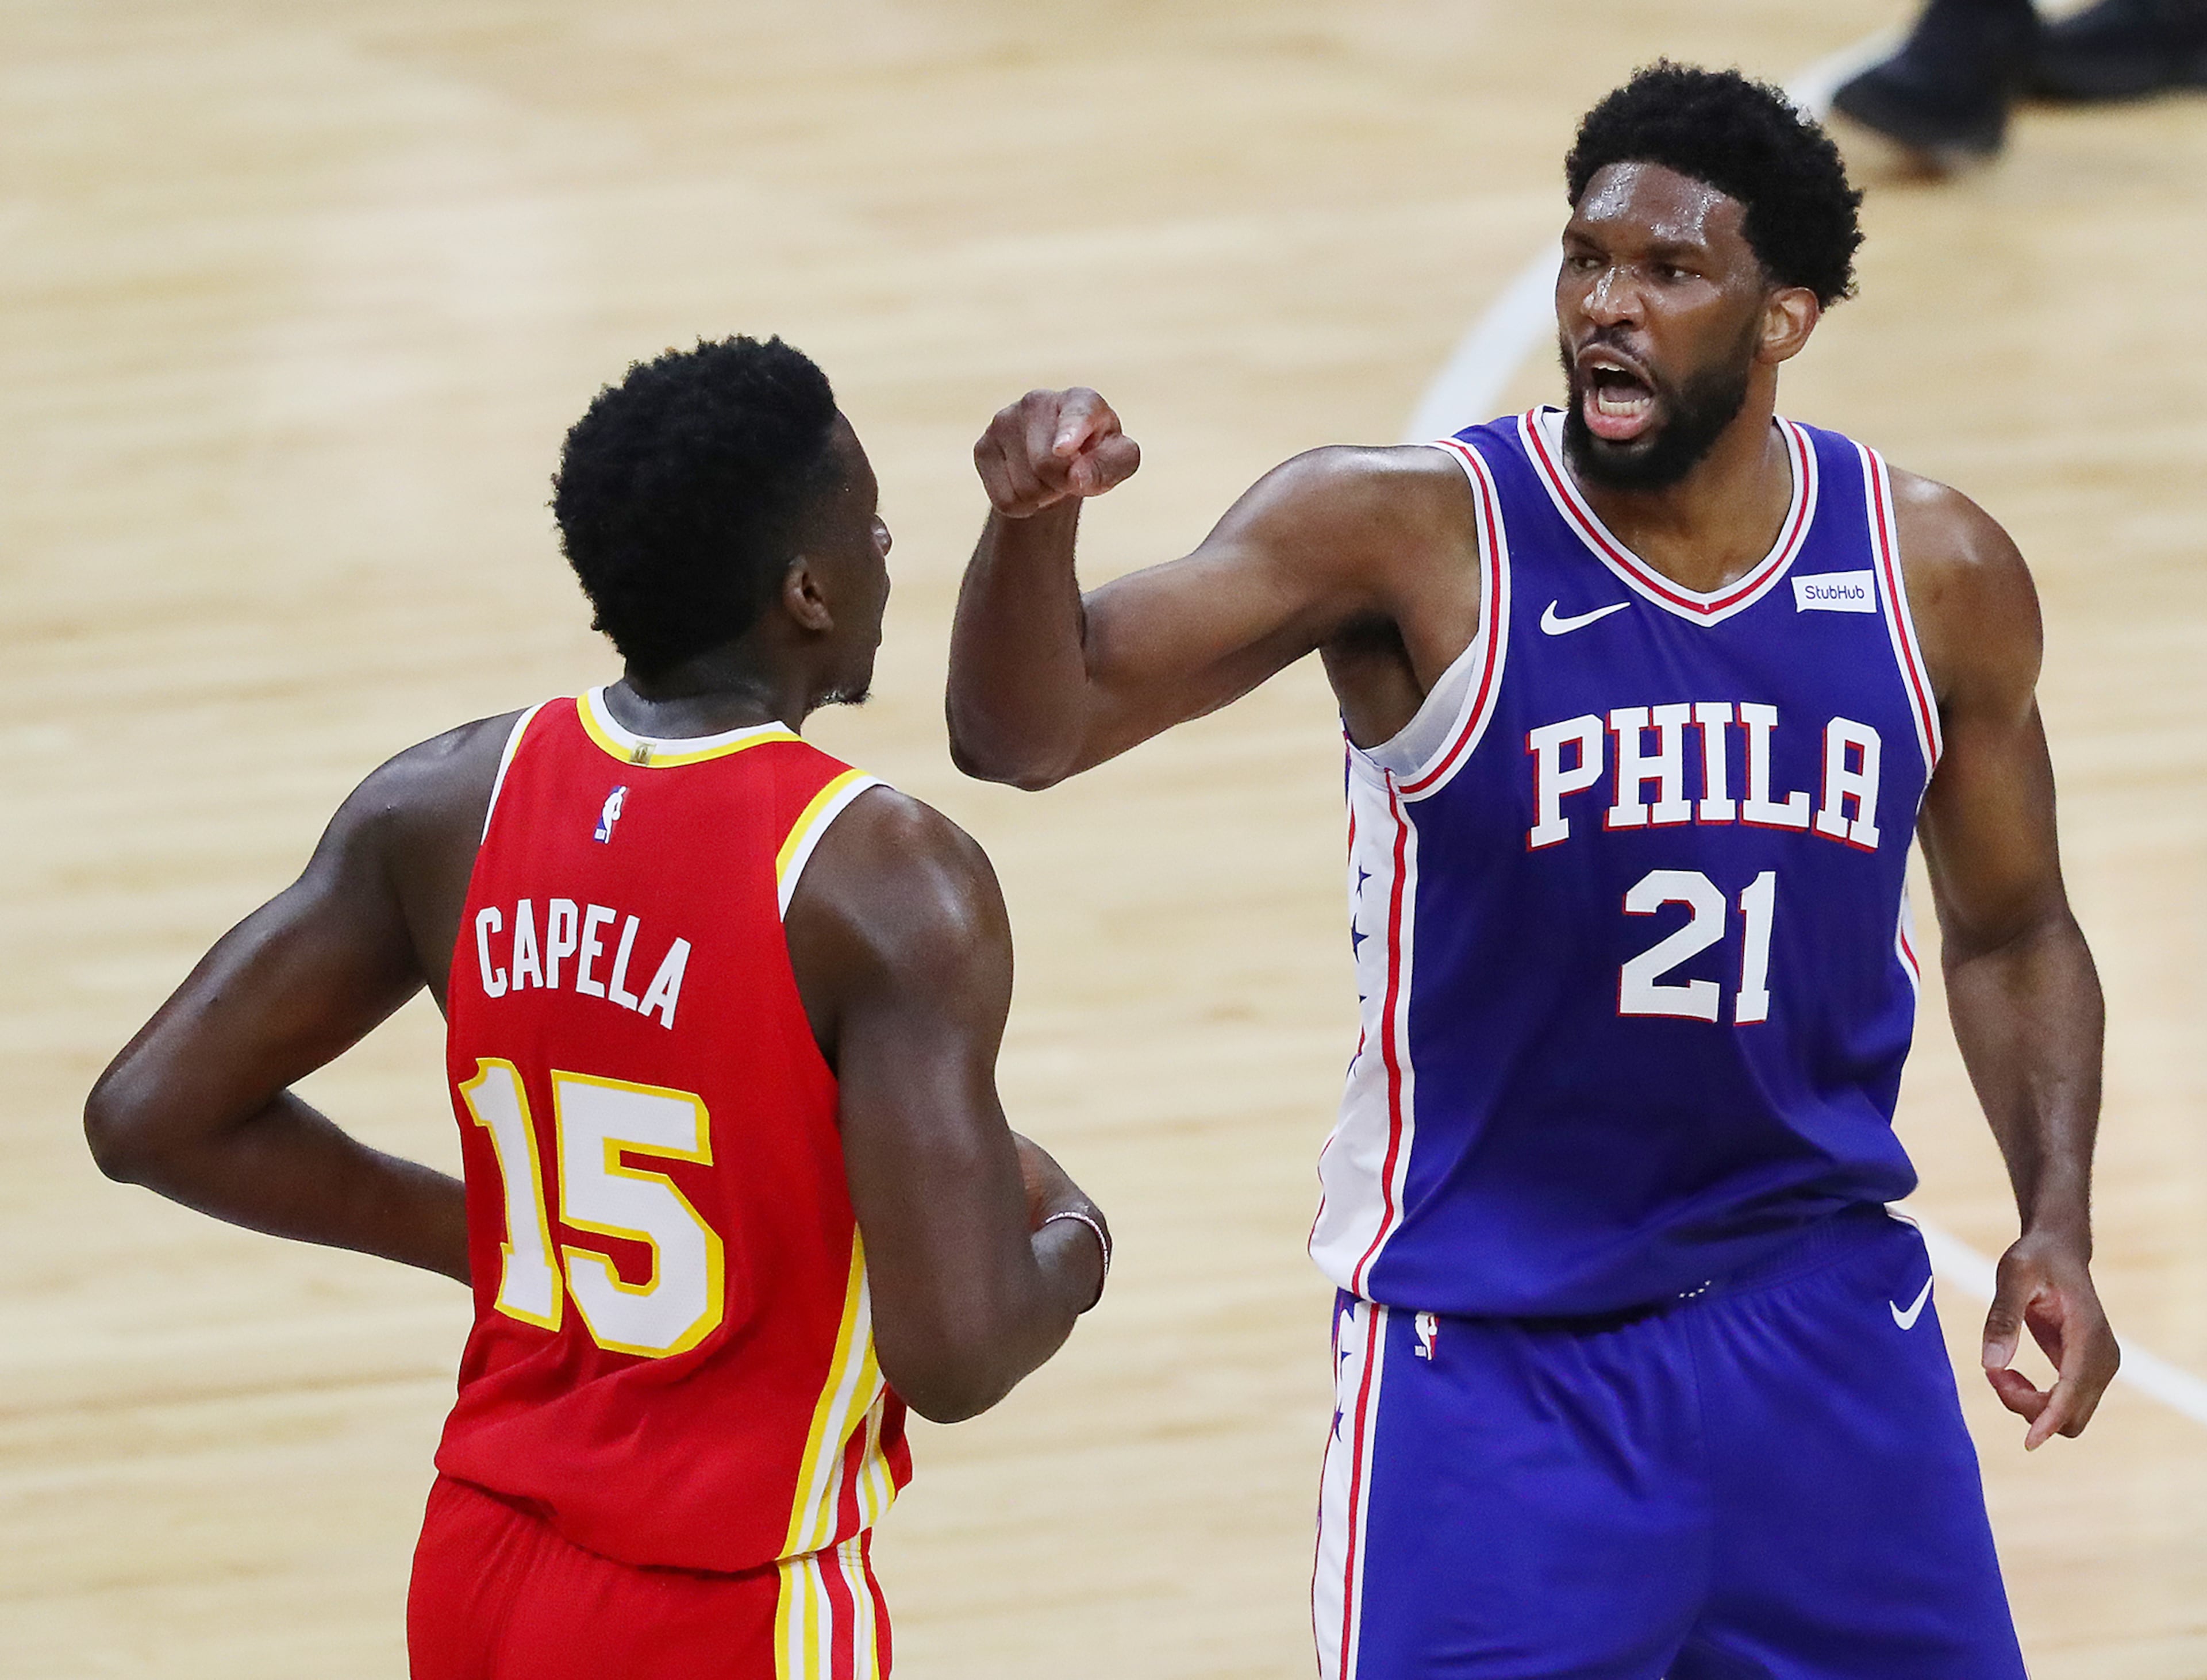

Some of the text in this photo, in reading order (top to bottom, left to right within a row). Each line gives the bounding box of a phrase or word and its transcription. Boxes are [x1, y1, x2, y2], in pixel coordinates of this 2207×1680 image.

[1805, 585, 1864, 599] StubHub
[1527, 702, 1881, 851] PHILA
[475, 899, 691, 1029] CAPELA
[1618, 870, 1776, 1025] 21
[459, 1058, 724, 1358] 15
